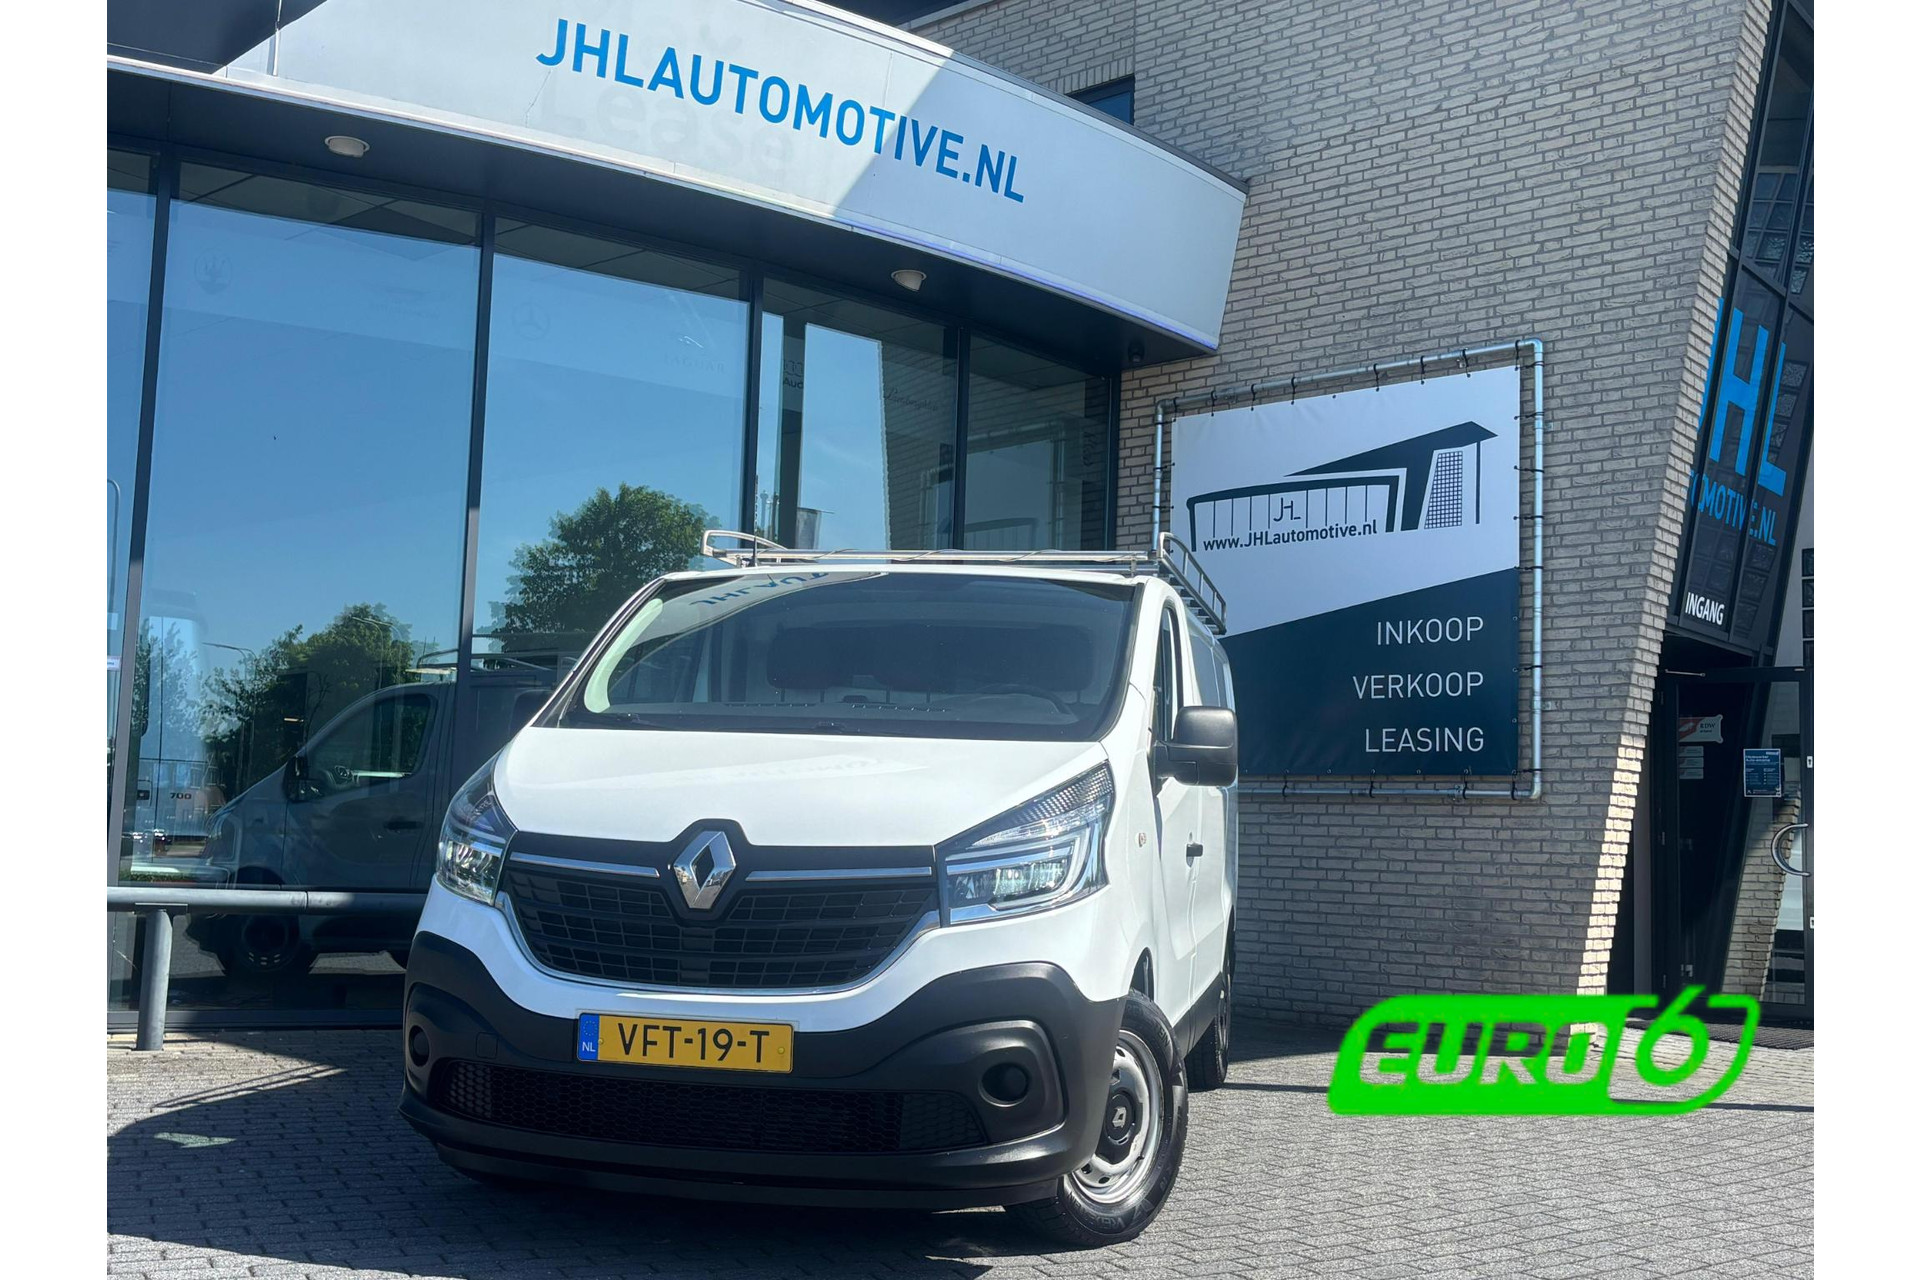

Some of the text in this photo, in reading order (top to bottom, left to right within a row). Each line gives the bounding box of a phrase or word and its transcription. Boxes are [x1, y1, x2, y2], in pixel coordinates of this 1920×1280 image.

[536, 18, 1024, 204] JHLAUTOMOTIVE.NL
[1697, 297, 1787, 497] HL
[1203, 519, 1378, 551] www.JHLautomotive.nl
[1685, 591, 1725, 625] INGANG
[1376, 615, 1485, 646] INKOOP
[1352, 671, 1485, 700] VERKOOP
[1364, 727, 1485, 753] LEASING
[582, 1041, 596, 1052] NL
[617, 1022, 770, 1063] VFT-19-T
